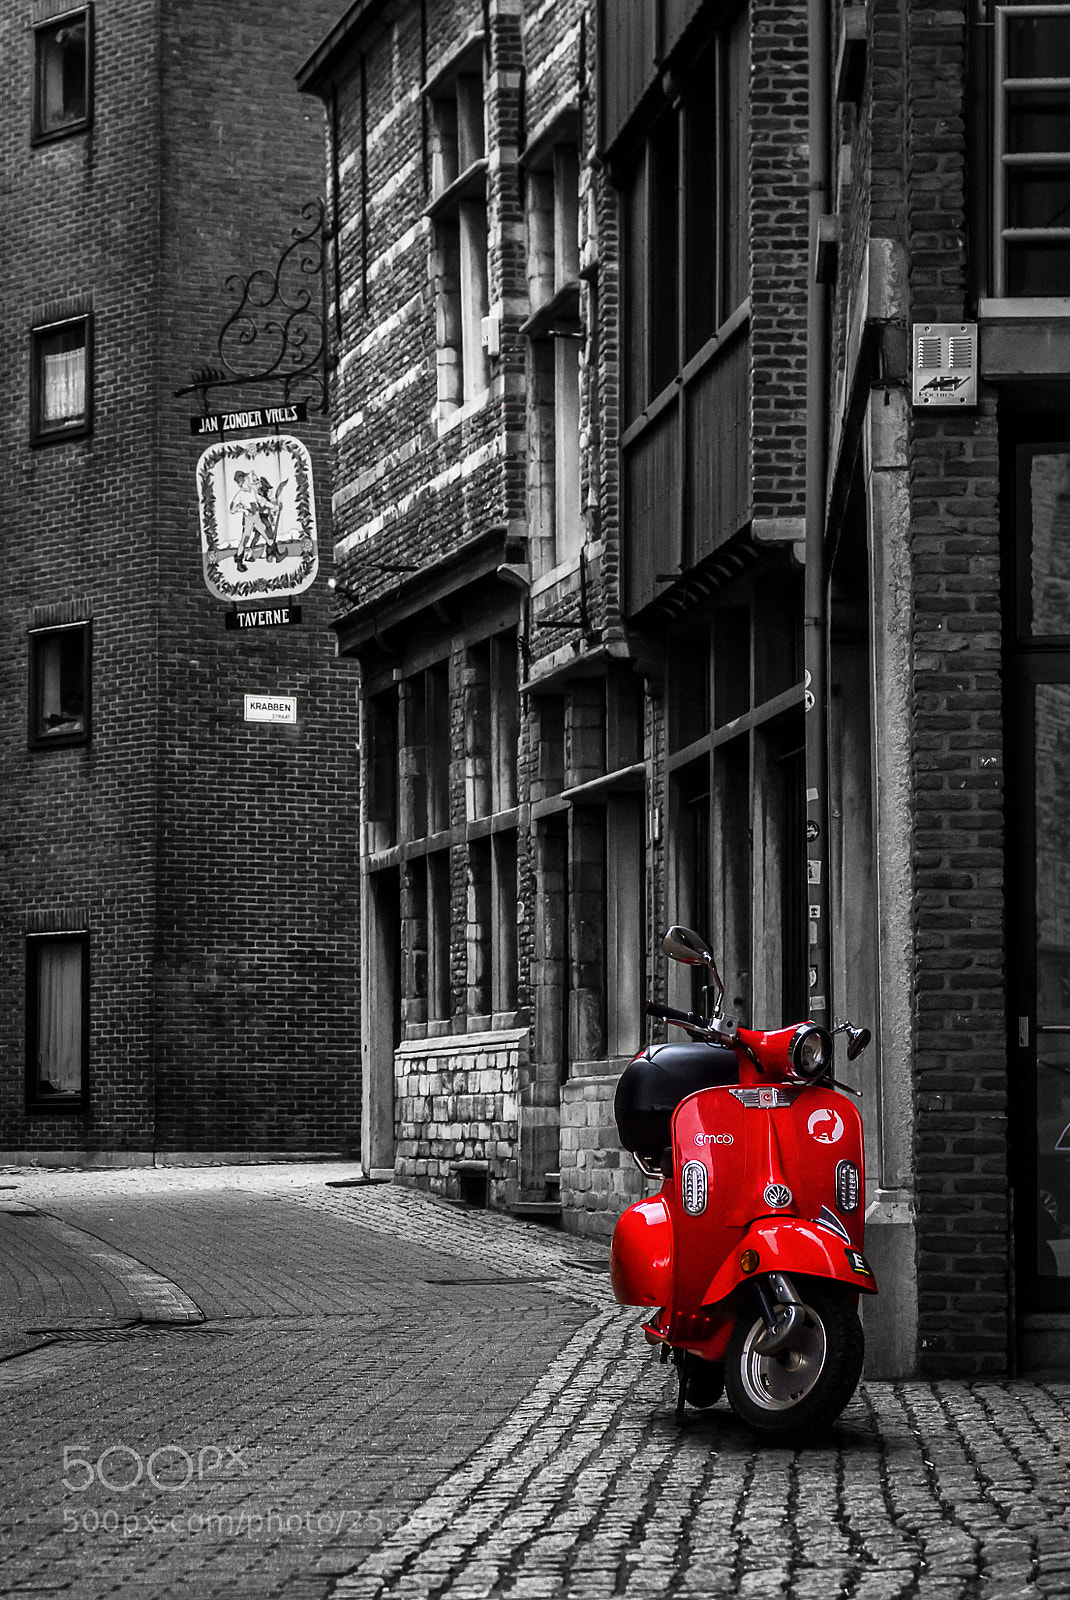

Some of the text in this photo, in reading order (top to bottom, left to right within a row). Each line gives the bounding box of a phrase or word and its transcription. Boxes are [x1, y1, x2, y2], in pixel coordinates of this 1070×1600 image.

[198, 405, 298, 433] JAN ZONDER VREES
[237, 608, 290, 628] TAVERNE
[250, 702, 291, 711] KRABBEN
[694, 1133, 734, 1146] emco
[852, 1252, 865, 1269] E
